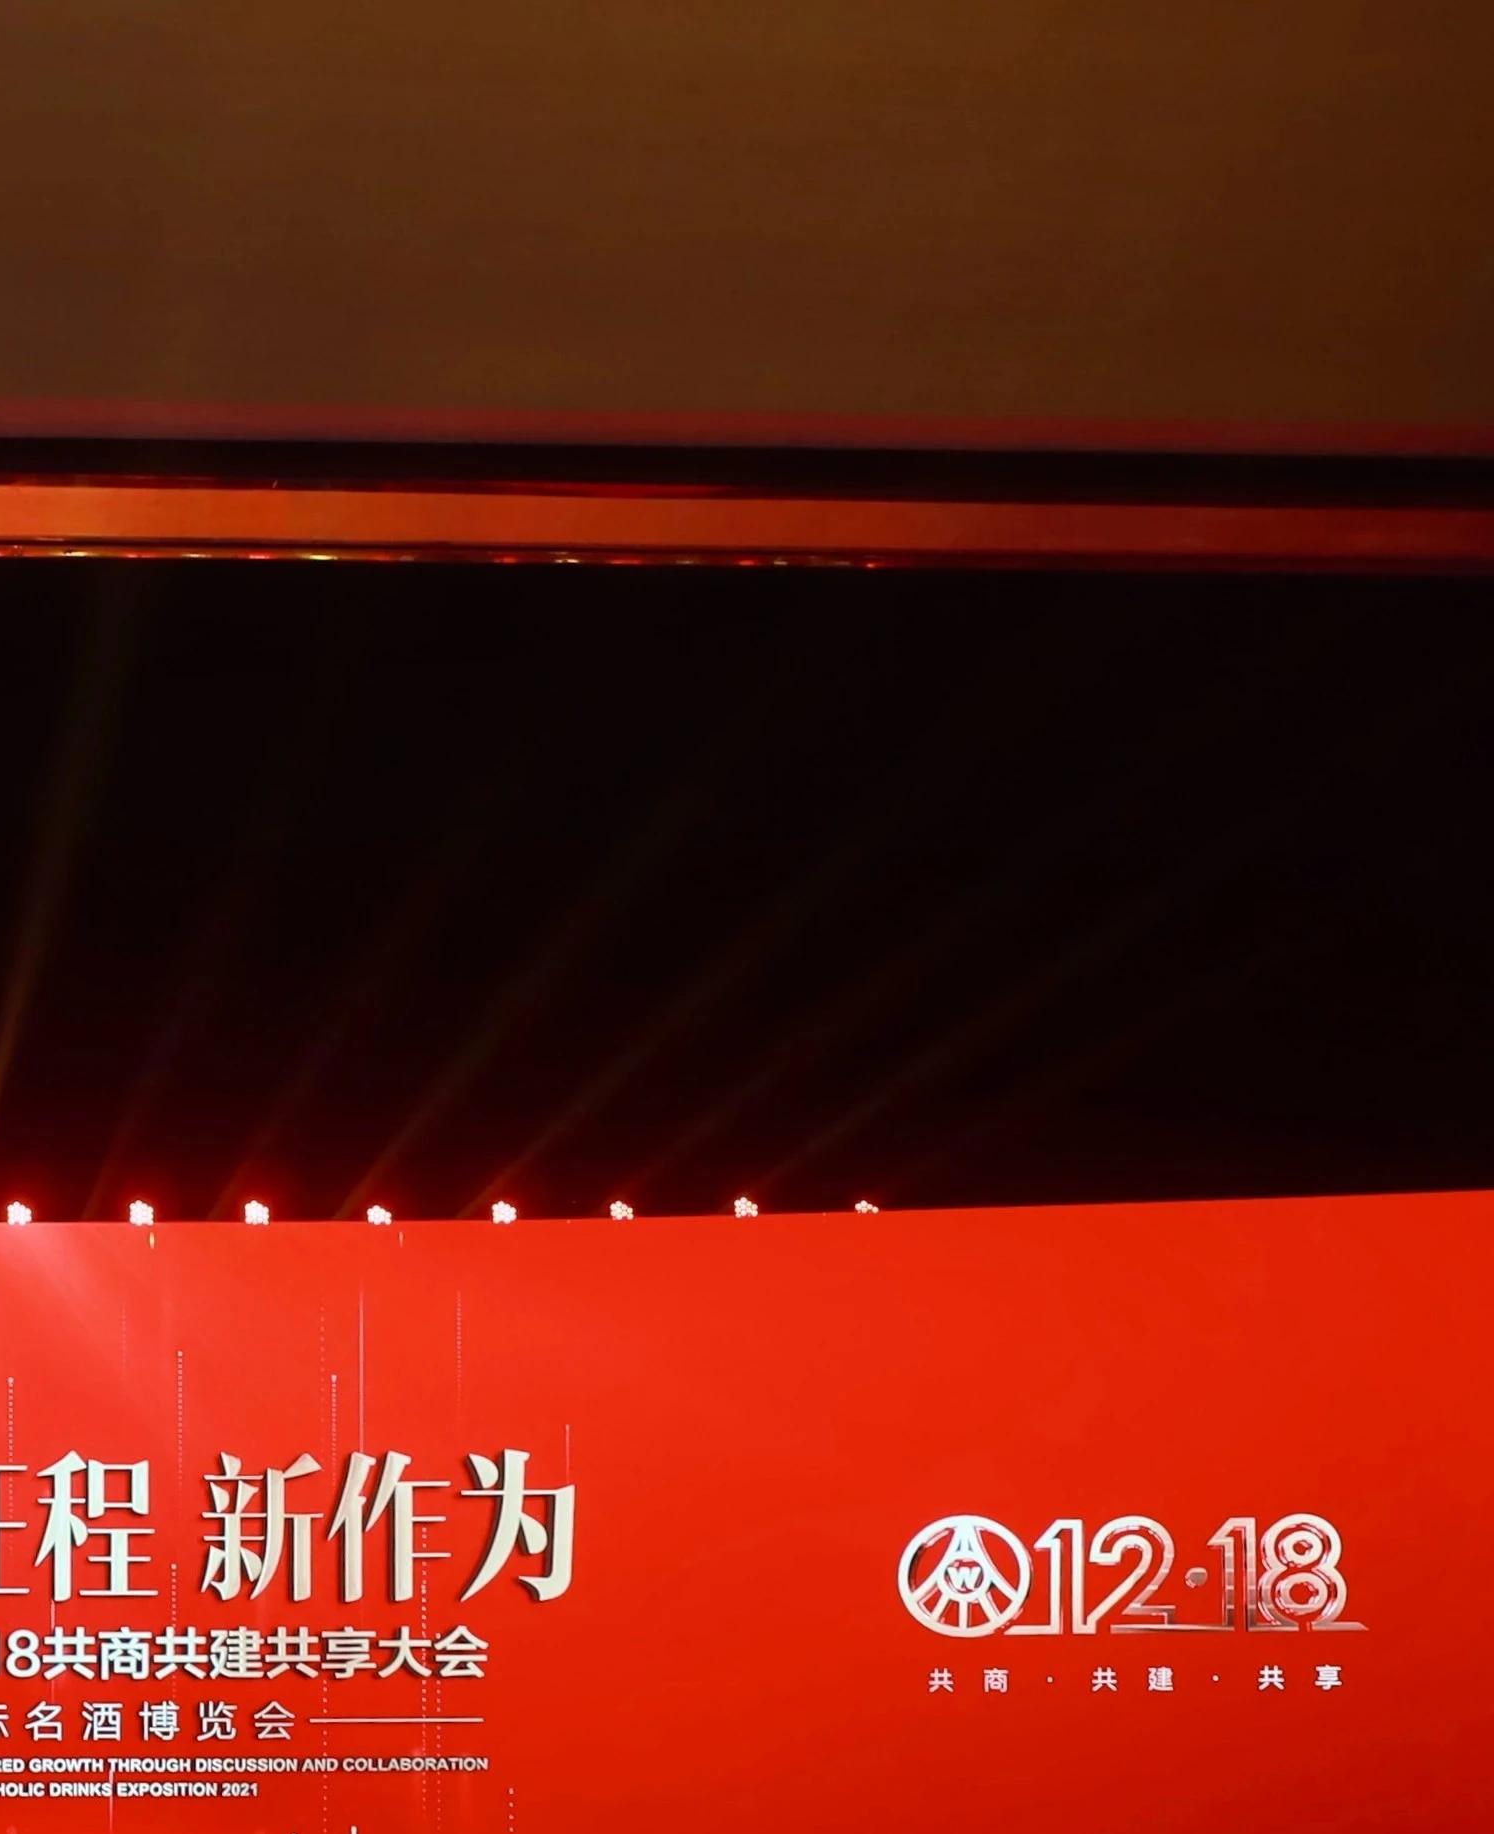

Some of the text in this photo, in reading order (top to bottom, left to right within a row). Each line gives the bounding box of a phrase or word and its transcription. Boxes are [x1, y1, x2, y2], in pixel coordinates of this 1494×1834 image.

[201, 1450, 576, 1603] 新作为
[29, 1757, 105, 1772] GROWTH
[108, 1757, 191, 1772] THROUGH
[195, 1757, 298, 1772] DISCUSSION
[302, 1757, 339, 1772] AND
[342, 1757, 489, 1772] COLLABORATION
[49, 1783, 112, 1798] DRINKS
[117, 1783, 217, 1798] EXPOSITION
[221, 1783, 258, 1798] 2021
